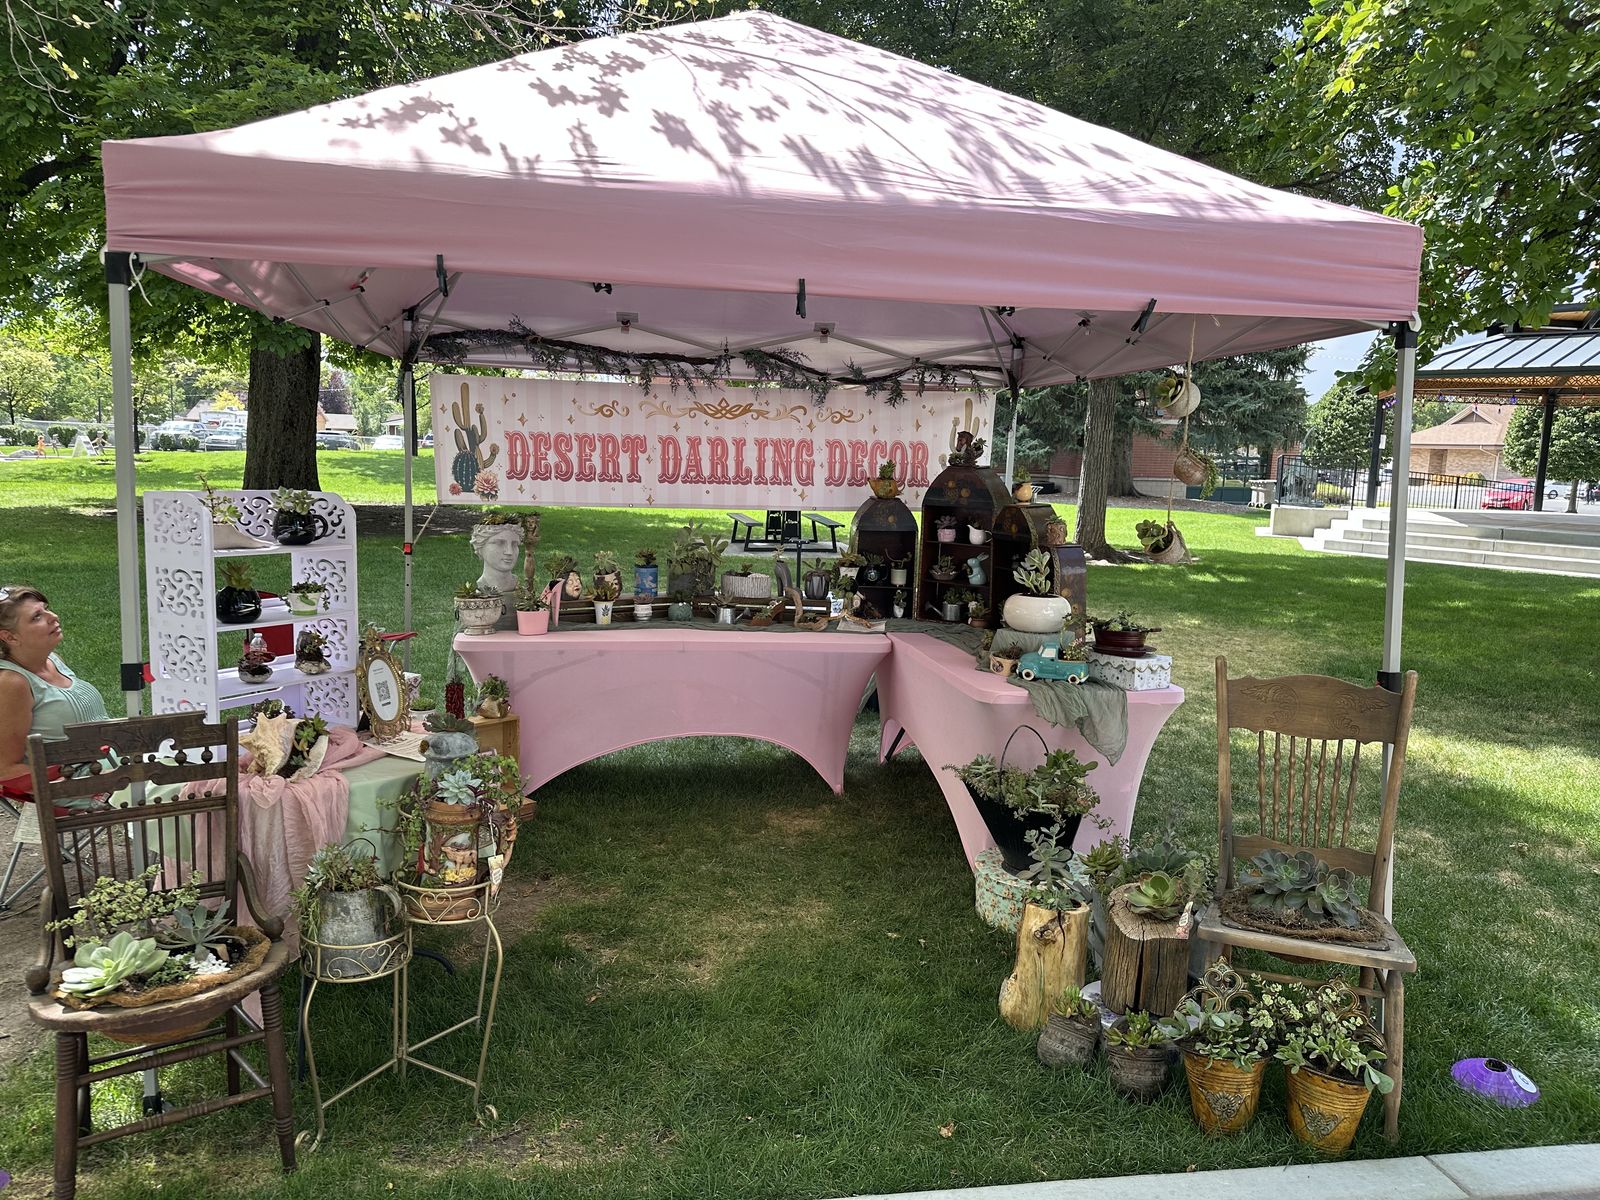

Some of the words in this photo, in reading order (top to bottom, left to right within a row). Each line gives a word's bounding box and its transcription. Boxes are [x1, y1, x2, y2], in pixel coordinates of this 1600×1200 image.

[504, 430, 647, 482] DESERT
[657, 434, 814, 485] DARLING
[825, 438, 930, 487] DECOR
